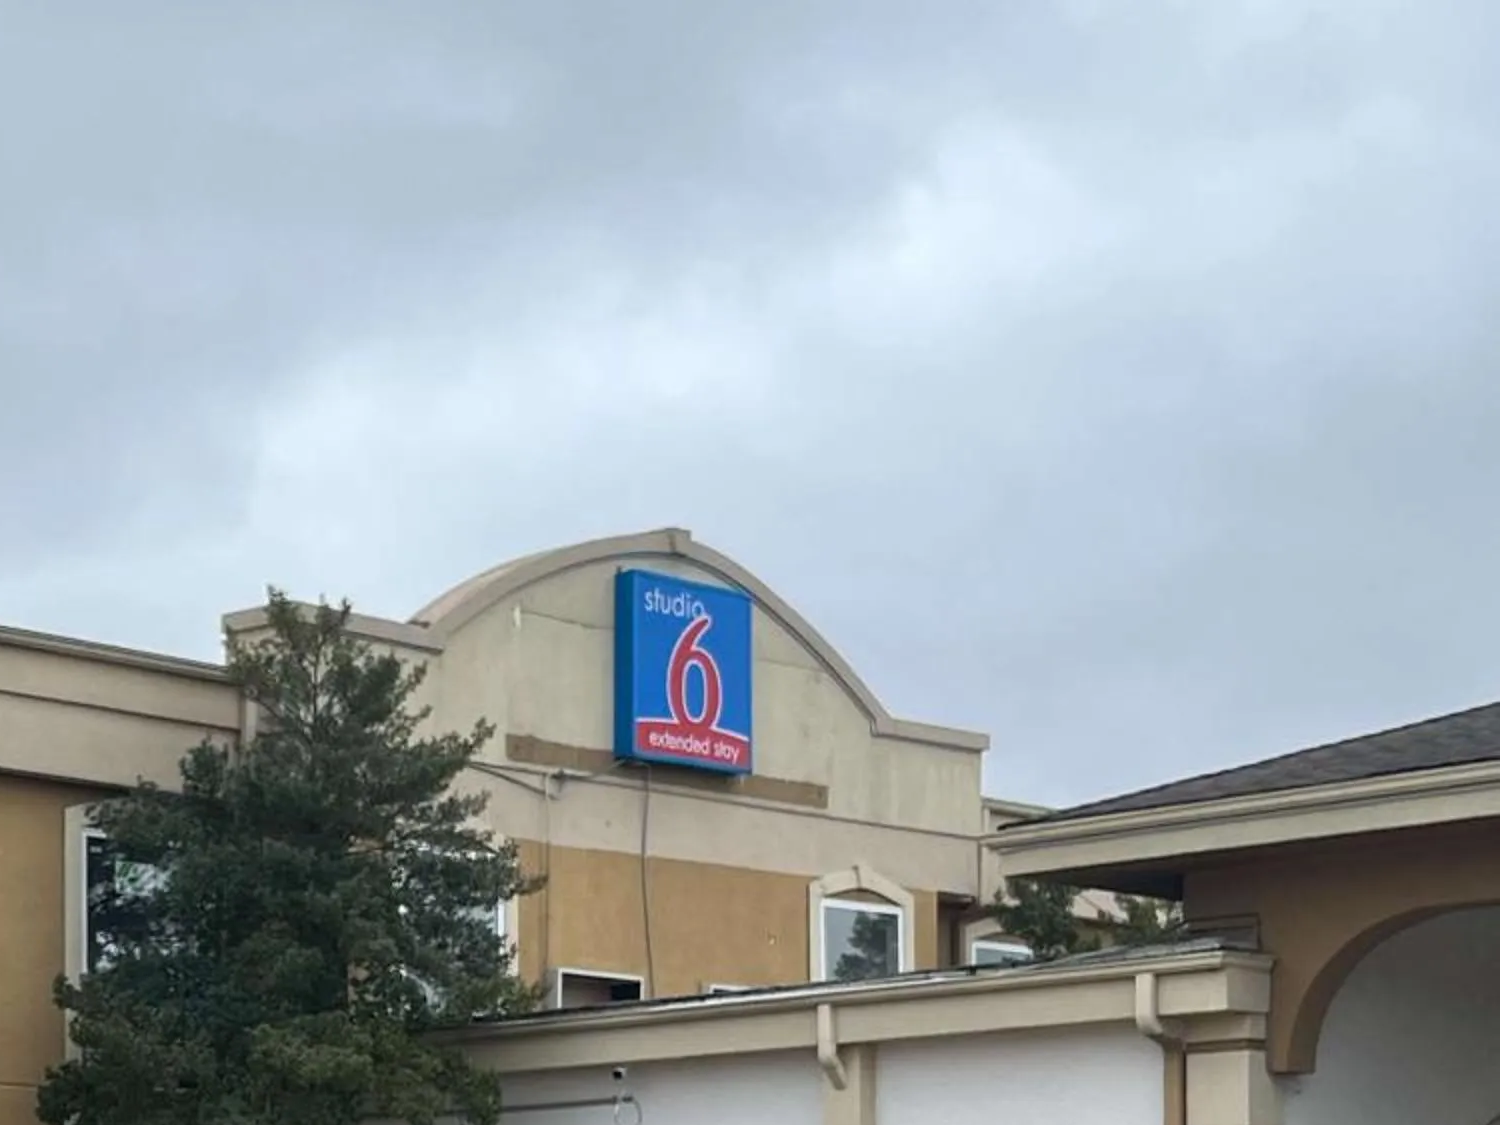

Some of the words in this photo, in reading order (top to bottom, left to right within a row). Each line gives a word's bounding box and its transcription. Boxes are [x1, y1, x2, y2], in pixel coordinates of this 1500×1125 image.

[644, 588, 705, 619] studio
[666, 615, 722, 728] 6
[649, 730, 710, 756] extended
[713, 740, 739, 765] stay
